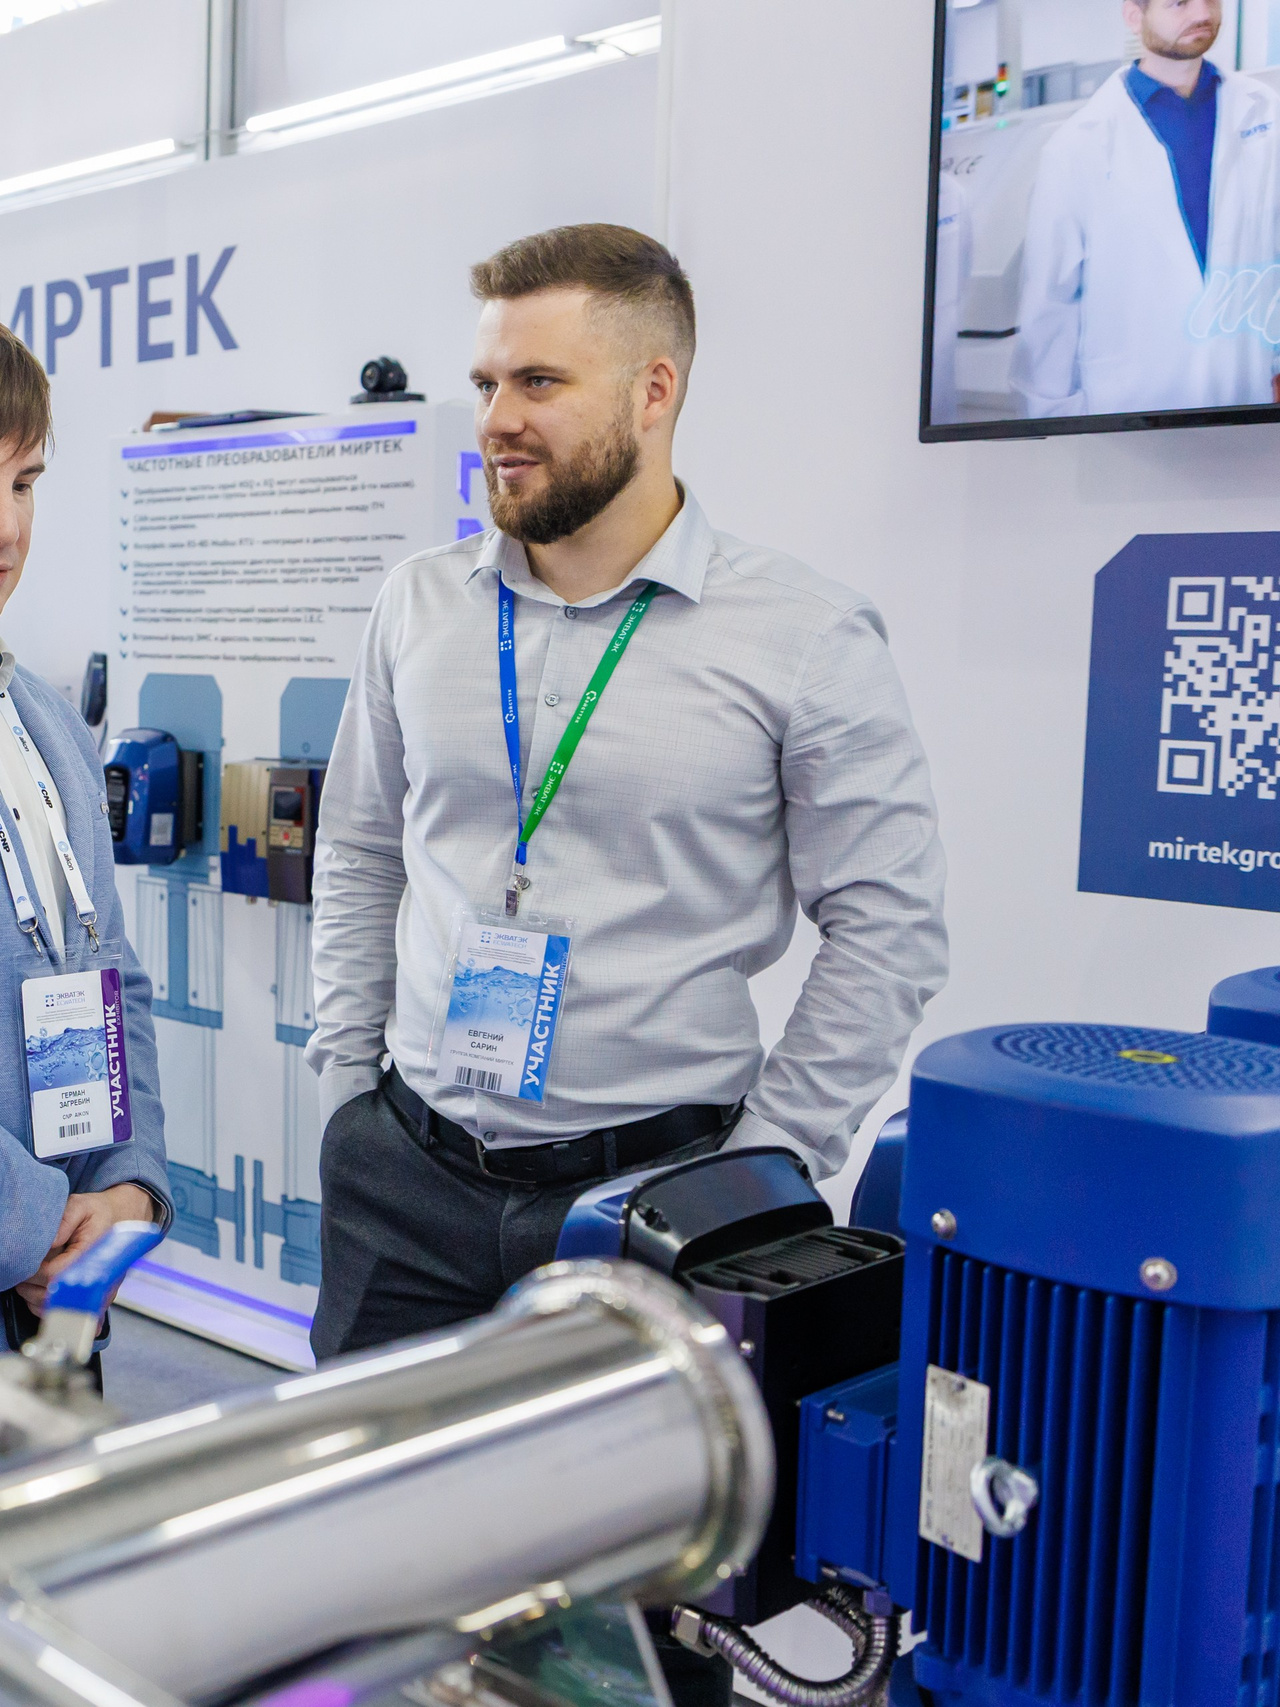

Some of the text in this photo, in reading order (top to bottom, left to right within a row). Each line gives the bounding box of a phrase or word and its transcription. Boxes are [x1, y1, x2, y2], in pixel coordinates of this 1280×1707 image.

[128, 438, 404, 473] ЧАСТОТНЫЕ ПРЕОБРАЗОВАТЕЛИ МИРТЕК
[1148, 836, 1280, 873] mirtekgro
[493, 932, 529, 944] ЭКВАТЭК
[56, 990, 86, 1000] ЭКВАТЭК
[524, 962, 561, 1087] УЧАСТНИК
[467, 1029, 504, 1043] ЕВГЕНИЙ
[470, 1041, 498, 1053] САРИН
[104, 1003, 125, 1119] УЧАСТНИК
[61, 1089, 86, 1100] ГЕРМАН
[59, 1098, 91, 1110] ЗАГРЕБИН
